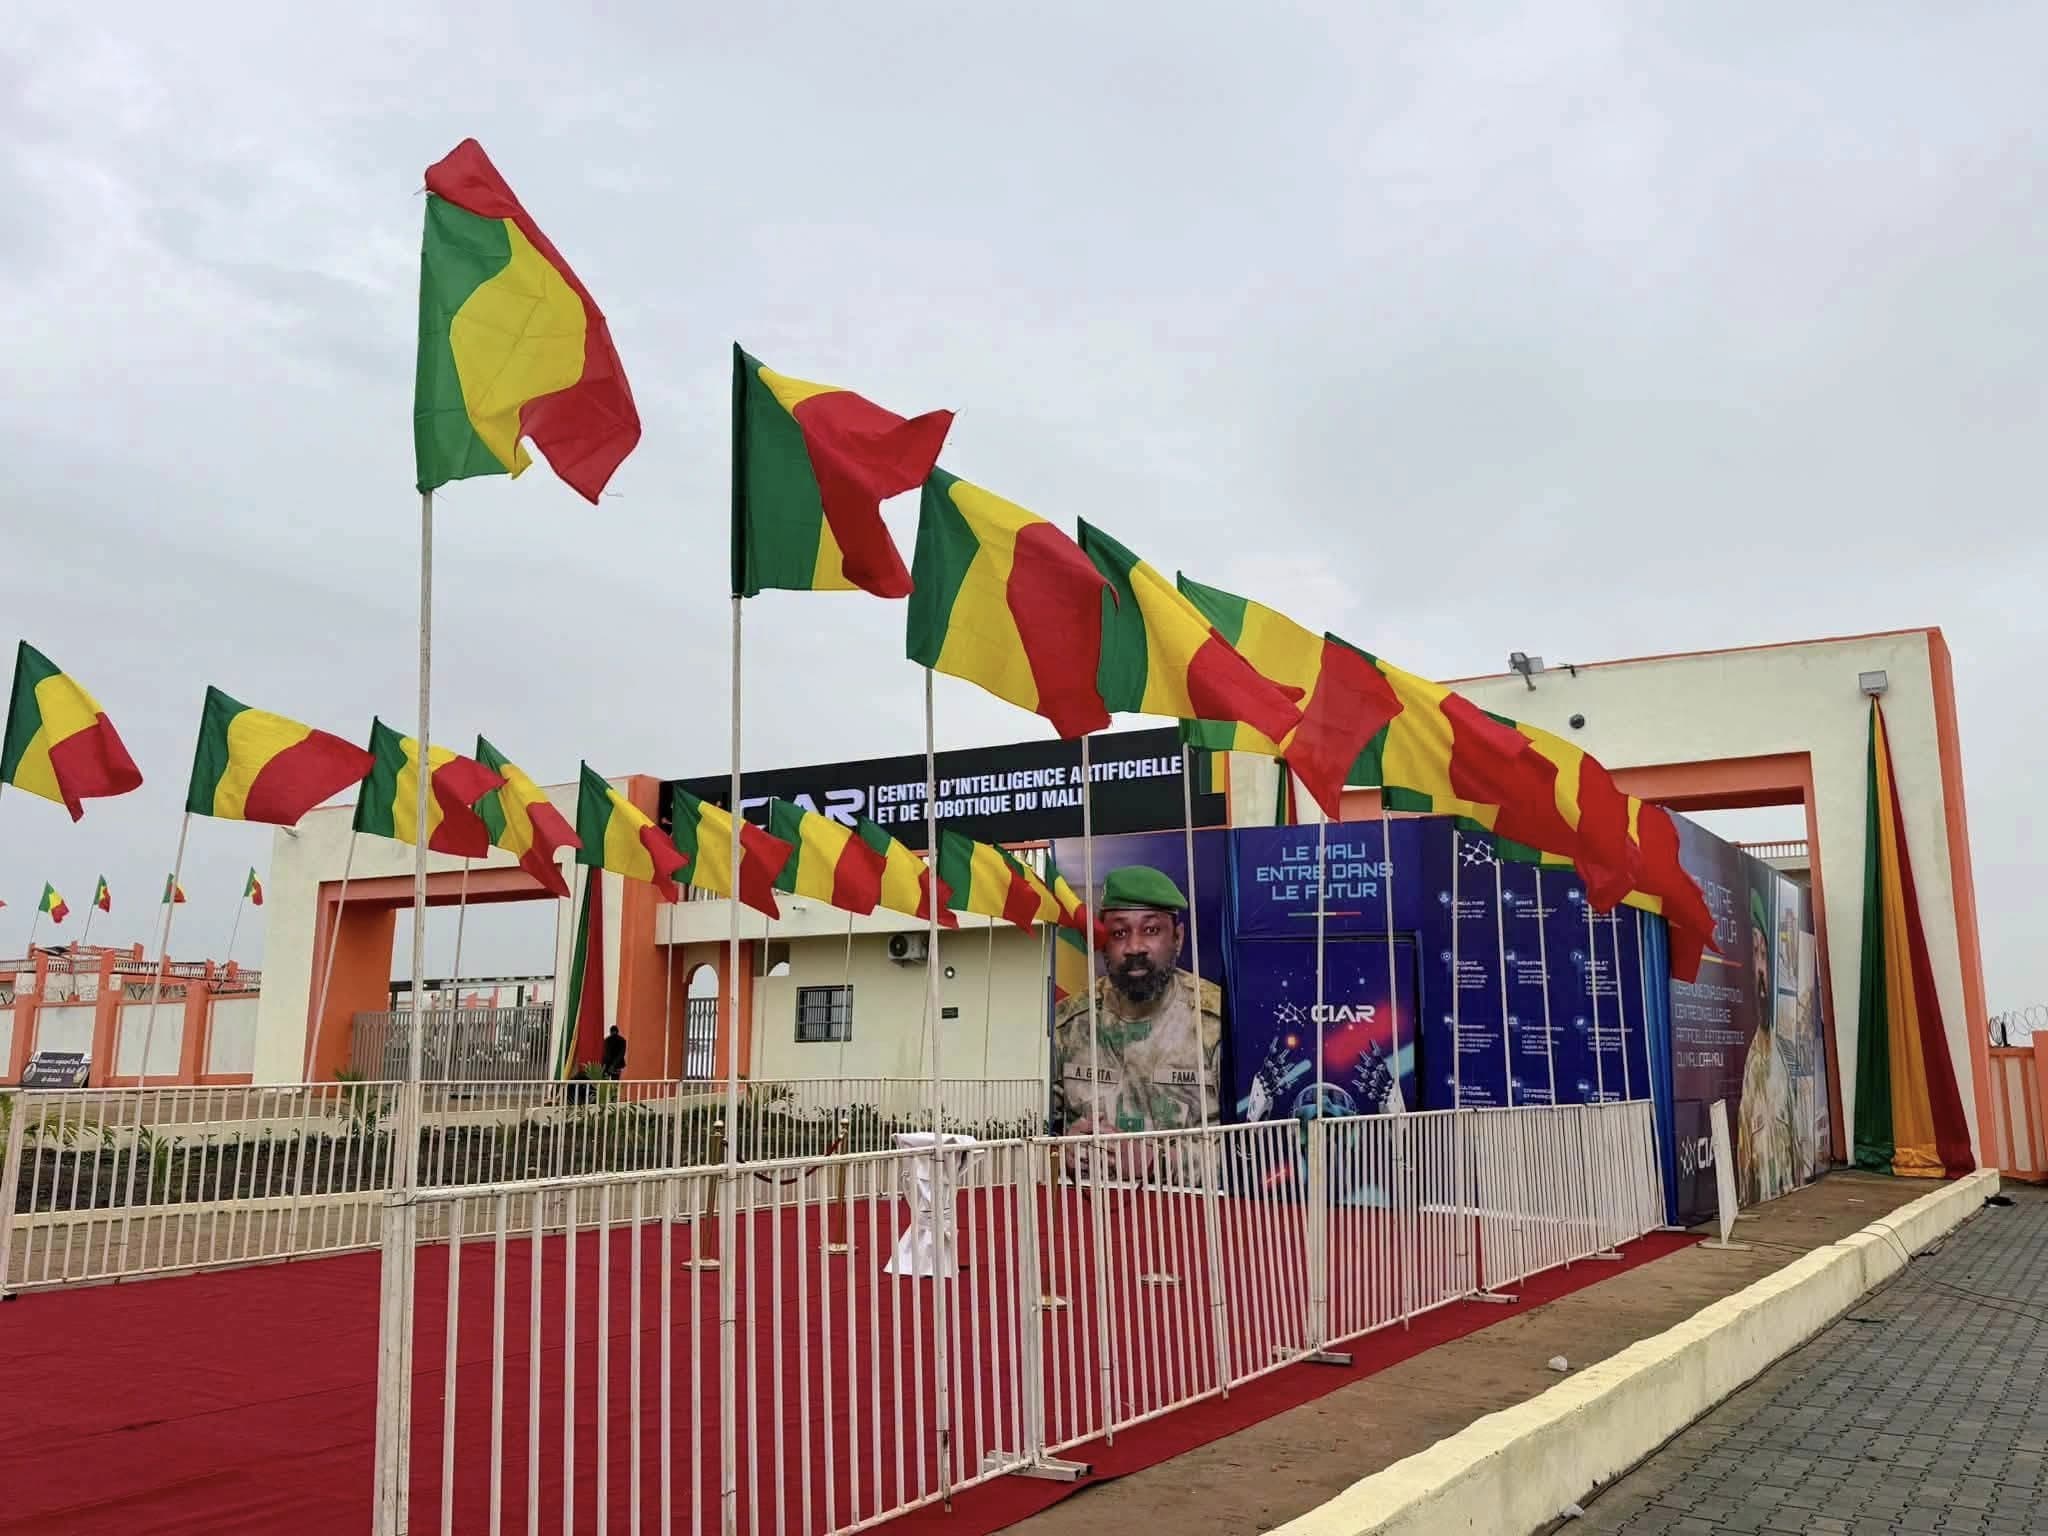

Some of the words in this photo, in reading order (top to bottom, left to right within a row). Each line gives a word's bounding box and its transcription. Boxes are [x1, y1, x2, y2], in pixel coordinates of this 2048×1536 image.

[940, 768, 1066, 797] D'INTELLIGENCE
[877, 805, 896, 824] ET
[900, 803, 920, 822] DE
[1015, 791, 1038, 811] DU
[1042, 787, 1083, 809] MALI
[1282, 846, 1310, 862] LE
[1256, 864, 1326, 882] ENTRE
[1332, 862, 1394, 880] DANS
[1272, 885, 1299, 901] LE
[1310, 1004, 1376, 1023] CIAR
[1086, 1067, 1111, 1081] GITA
[1172, 1071, 1196, 1083] FAMA
